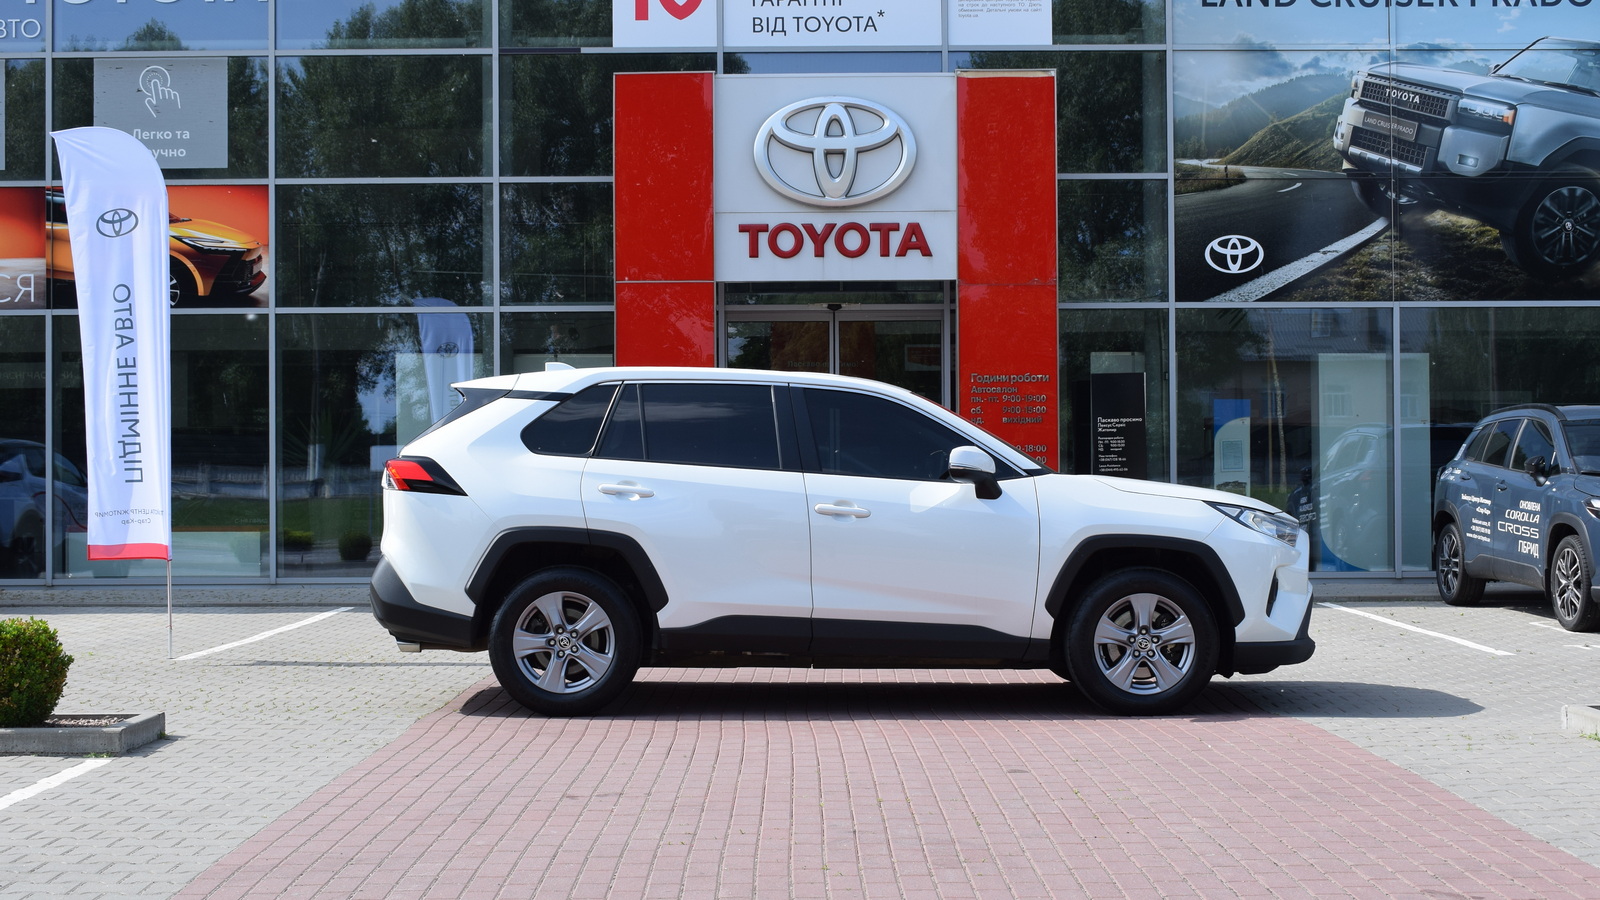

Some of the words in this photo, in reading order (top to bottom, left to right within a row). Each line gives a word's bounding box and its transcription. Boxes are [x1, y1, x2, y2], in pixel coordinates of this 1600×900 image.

[752, 16, 787, 36] ВІД
[1385, 88, 1420, 104] TOYOTA
[1364, 116, 1377, 125] LAND
[1397, 124, 1413, 134] PRADO
[133, 128, 172, 140] Легко
[175, 130, 190, 140] та
[151, 148, 186, 160] учно
[738, 221, 933, 258] TOYOTA
[970, 373, 1009, 384] Години
[1010, 372, 1050, 384] роботи
[971, 385, 1018, 393] Автосалон
[970, 406, 984, 414] сб.
[1002, 416, 1042, 424] вихідний
[1505, 508, 1540, 524] COROLLA
[1497, 520, 1539, 539] CROSS
